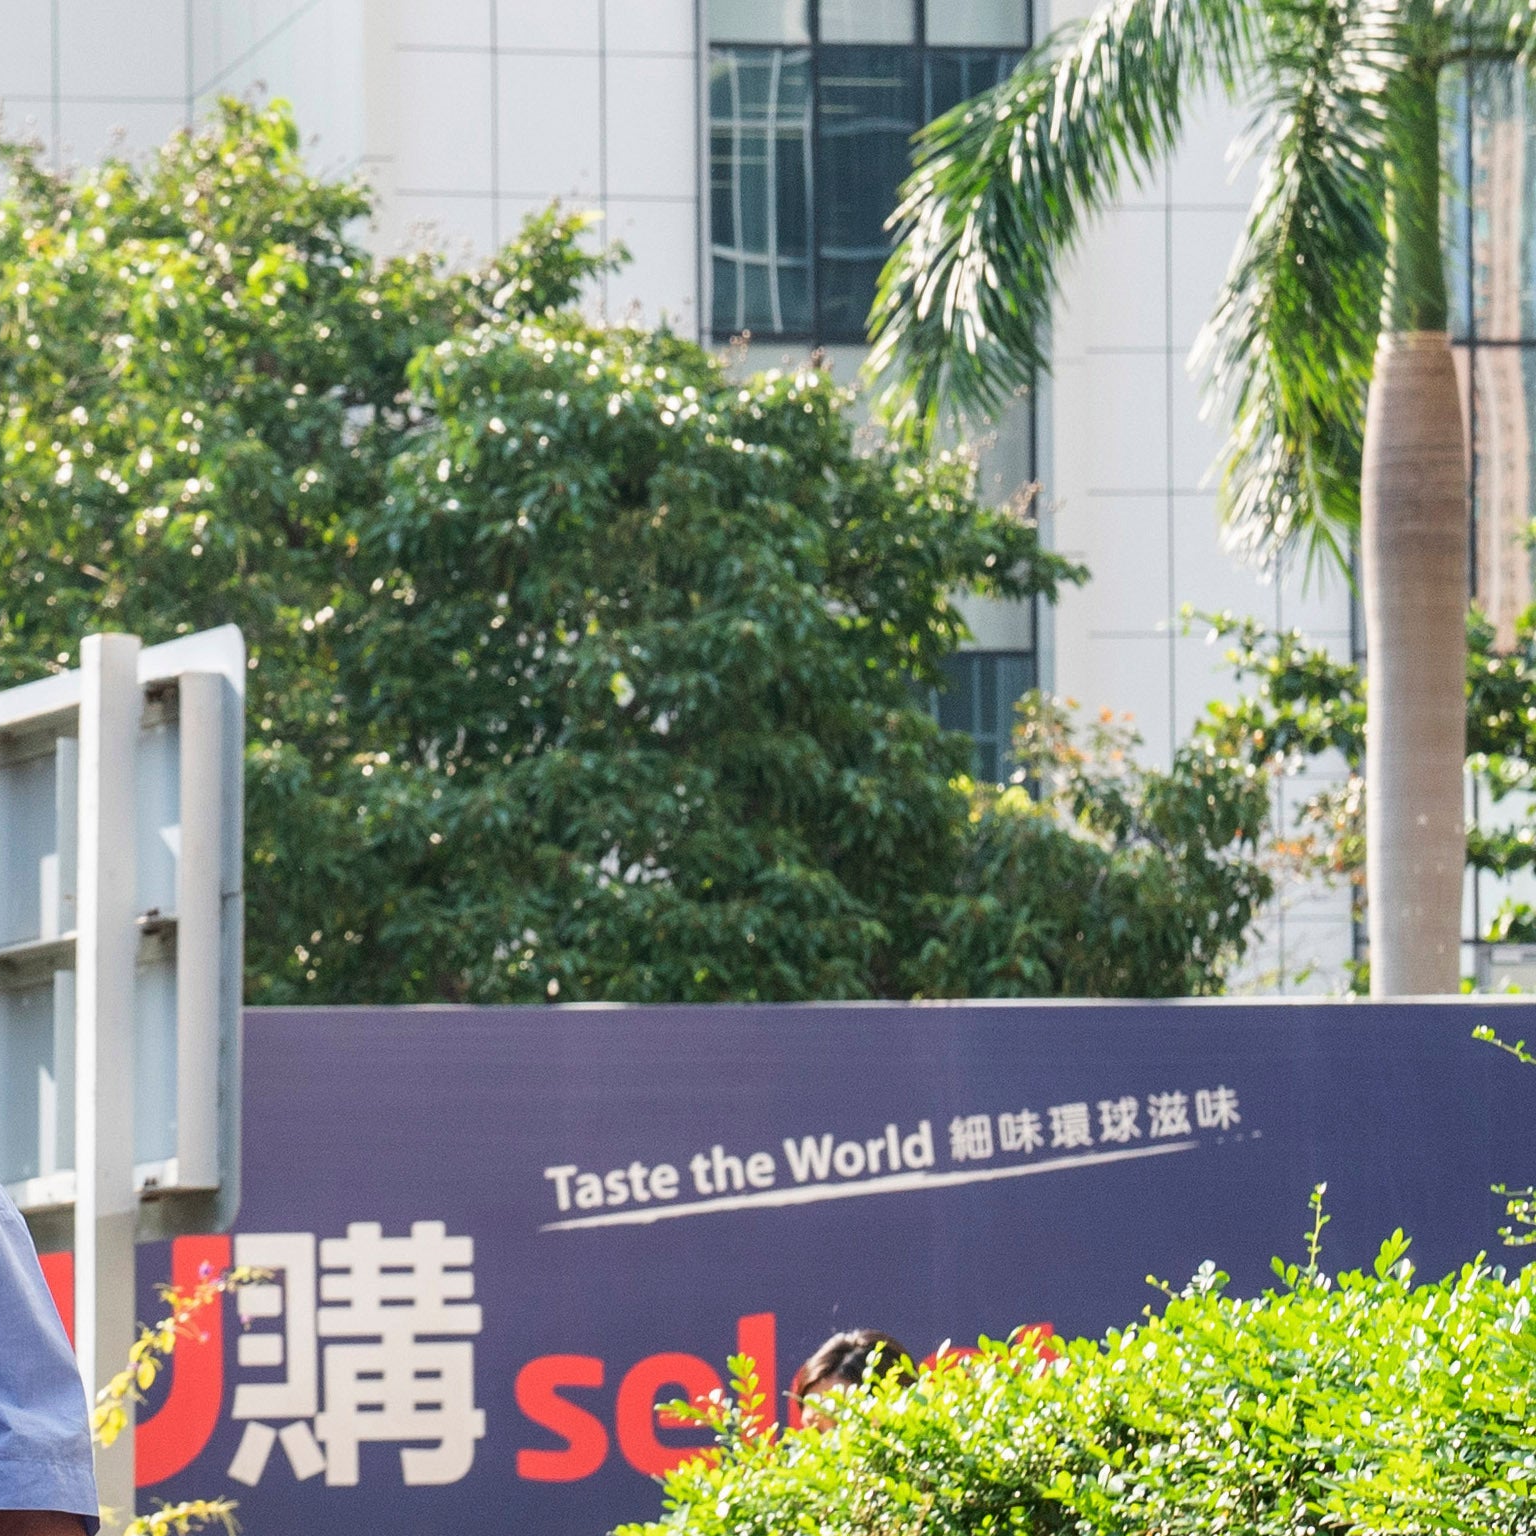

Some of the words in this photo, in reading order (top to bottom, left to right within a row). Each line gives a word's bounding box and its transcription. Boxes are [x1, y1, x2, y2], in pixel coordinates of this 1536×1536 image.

[544, 1165, 679, 1211] Taste
[690, 1145, 776, 1195] the
[783, 1120, 935, 1184] World
[948, 1085, 1242, 1163] 細味環球滋味
